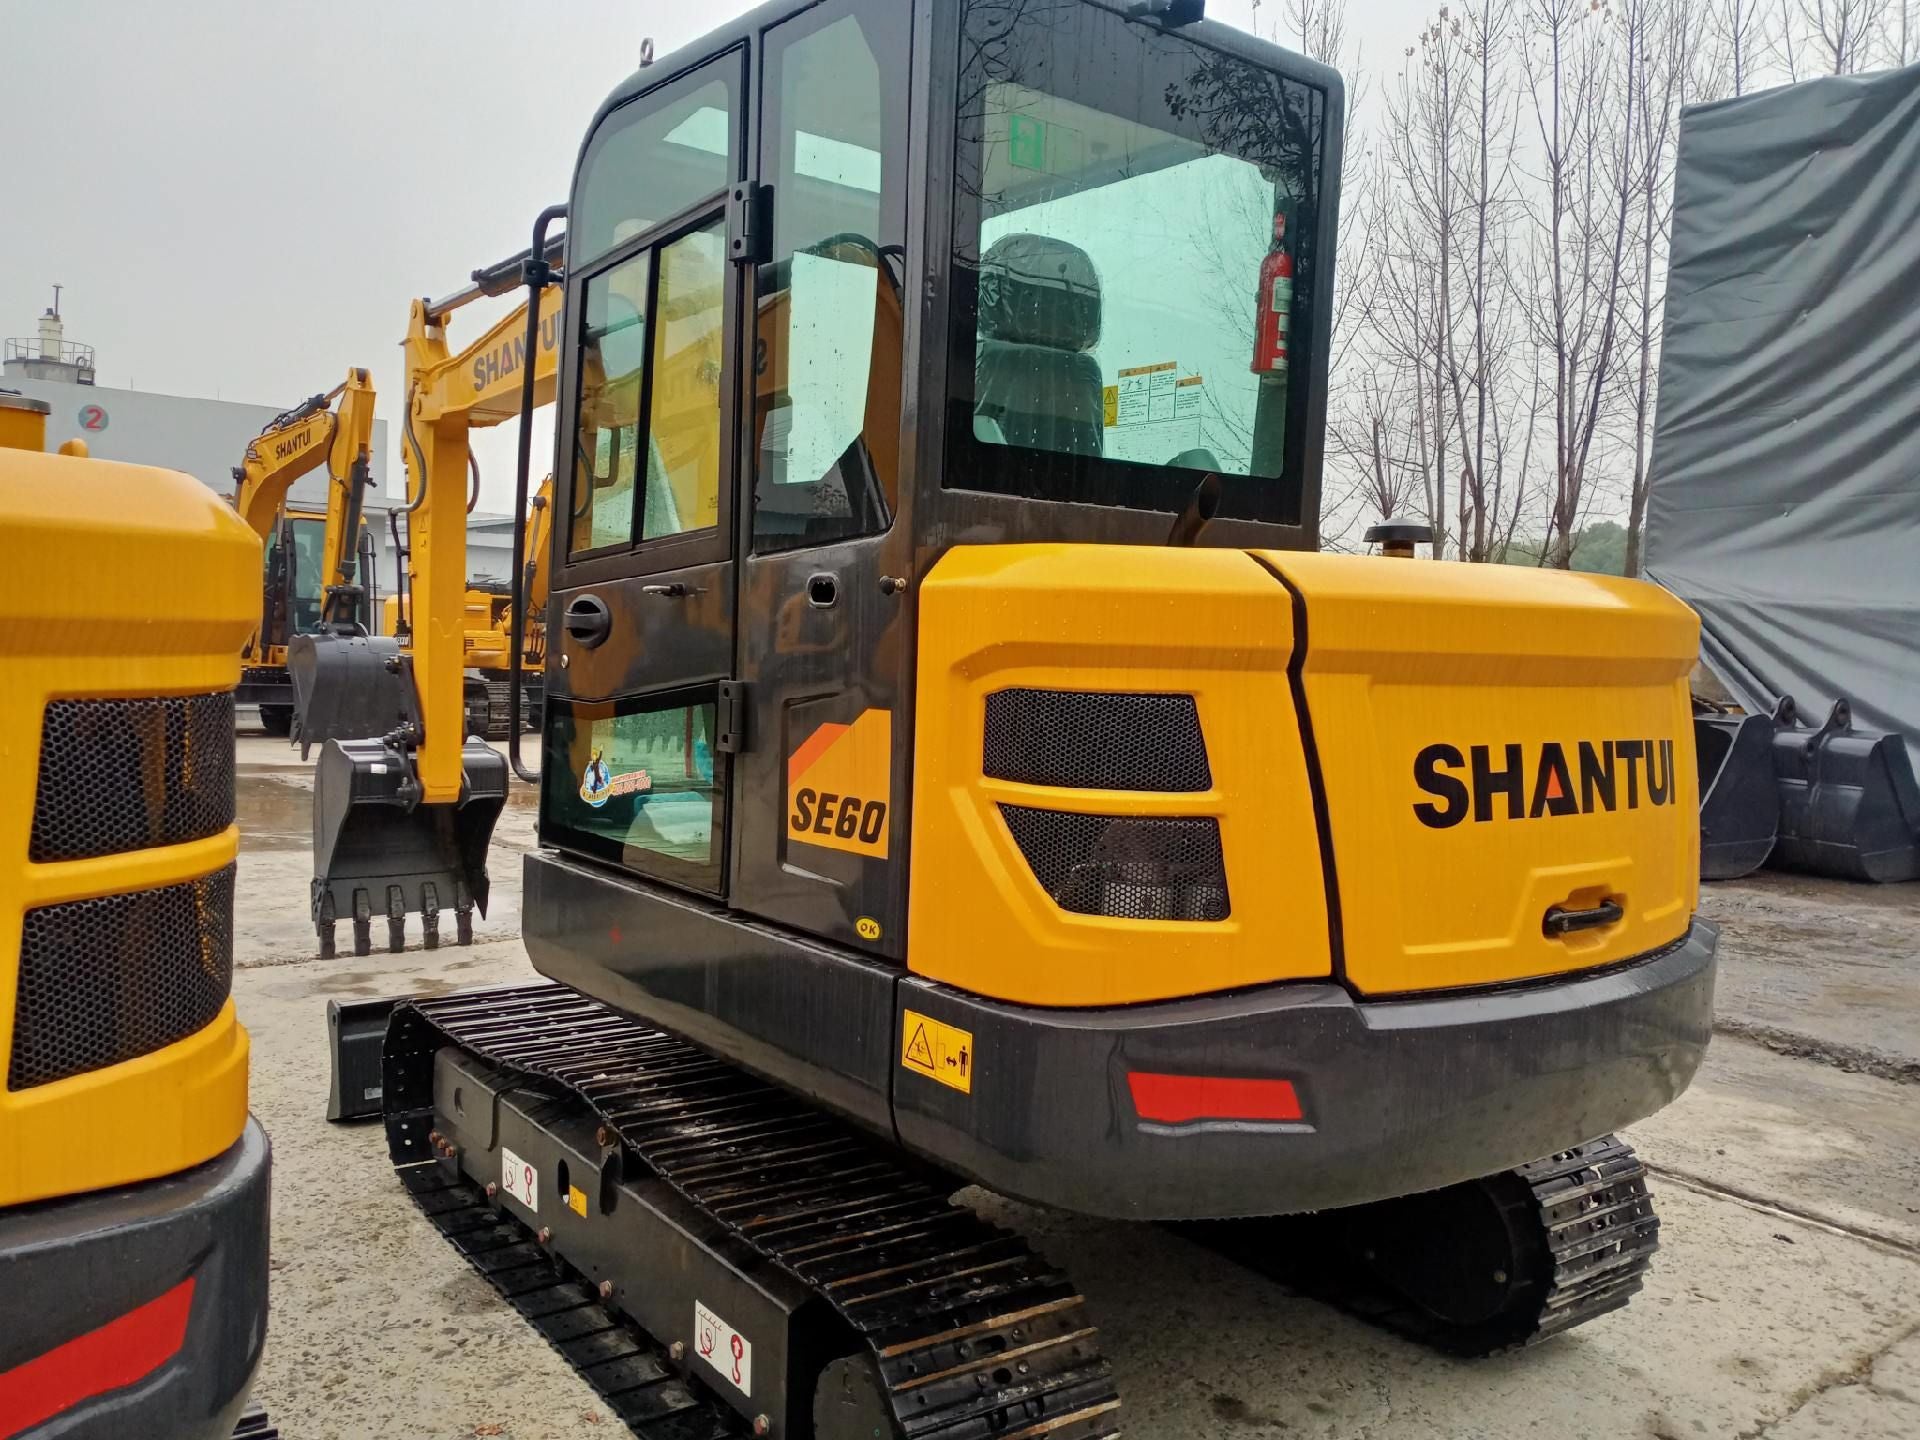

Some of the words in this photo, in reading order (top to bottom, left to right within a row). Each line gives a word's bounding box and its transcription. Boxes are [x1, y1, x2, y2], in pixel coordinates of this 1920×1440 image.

[474, 310, 562, 392] SHANUI
[86, 407, 104, 430] 2
[275, 427, 311, 461] SHANTUI
[1412, 739, 1676, 829] SHANTUI
[791, 787, 887, 845] SE60
[860, 923, 876, 936] OK
